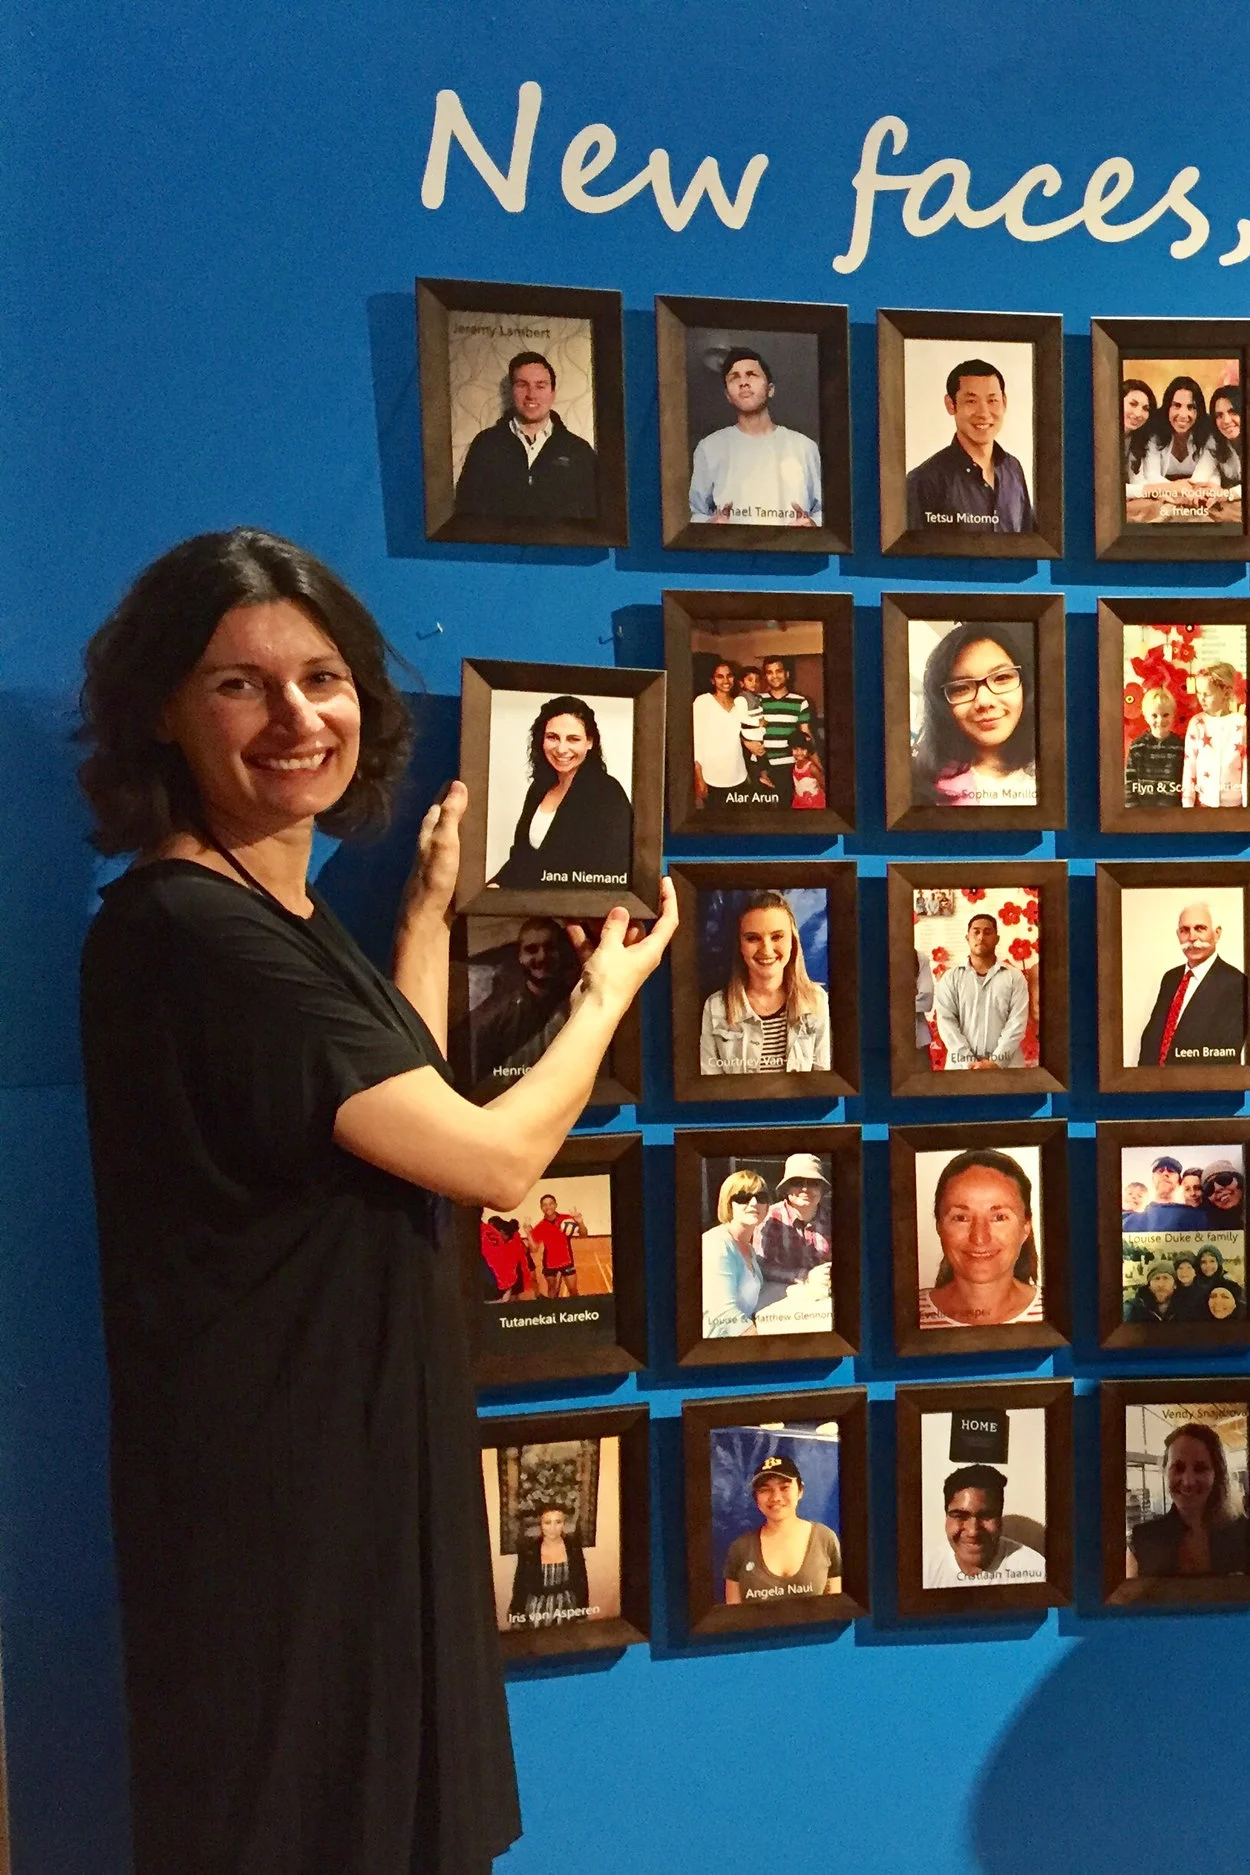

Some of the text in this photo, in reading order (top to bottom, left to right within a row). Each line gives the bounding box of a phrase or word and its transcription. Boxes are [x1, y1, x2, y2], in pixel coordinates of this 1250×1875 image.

[420, 80, 770, 232] New
[453, 324, 551, 339] Jeremy Lambert
[925, 511, 999, 524] Tetsu Mitomo
[1172, 506, 1209, 517] friends
[961, 789, 998, 803] Sophia
[1132, 782, 1153, 796] Flyn
[1156, 782, 1167, 794] &
[726, 792, 779, 803] Alar Arun
[541, 870, 628, 885] Jana Niemand
[1175, 1046, 1236, 1058] Leen Braam
[1128, 1231, 1239, 1244] Louise Duke & family
[500, 1309, 600, 1329] Tutanekai Kareko
[961, 1419, 998, 1433] HOME
[746, 1586, 785, 1600] Angela
[508, 1612, 527, 1624] Iris
[553, 1605, 600, 1621] Asperen
